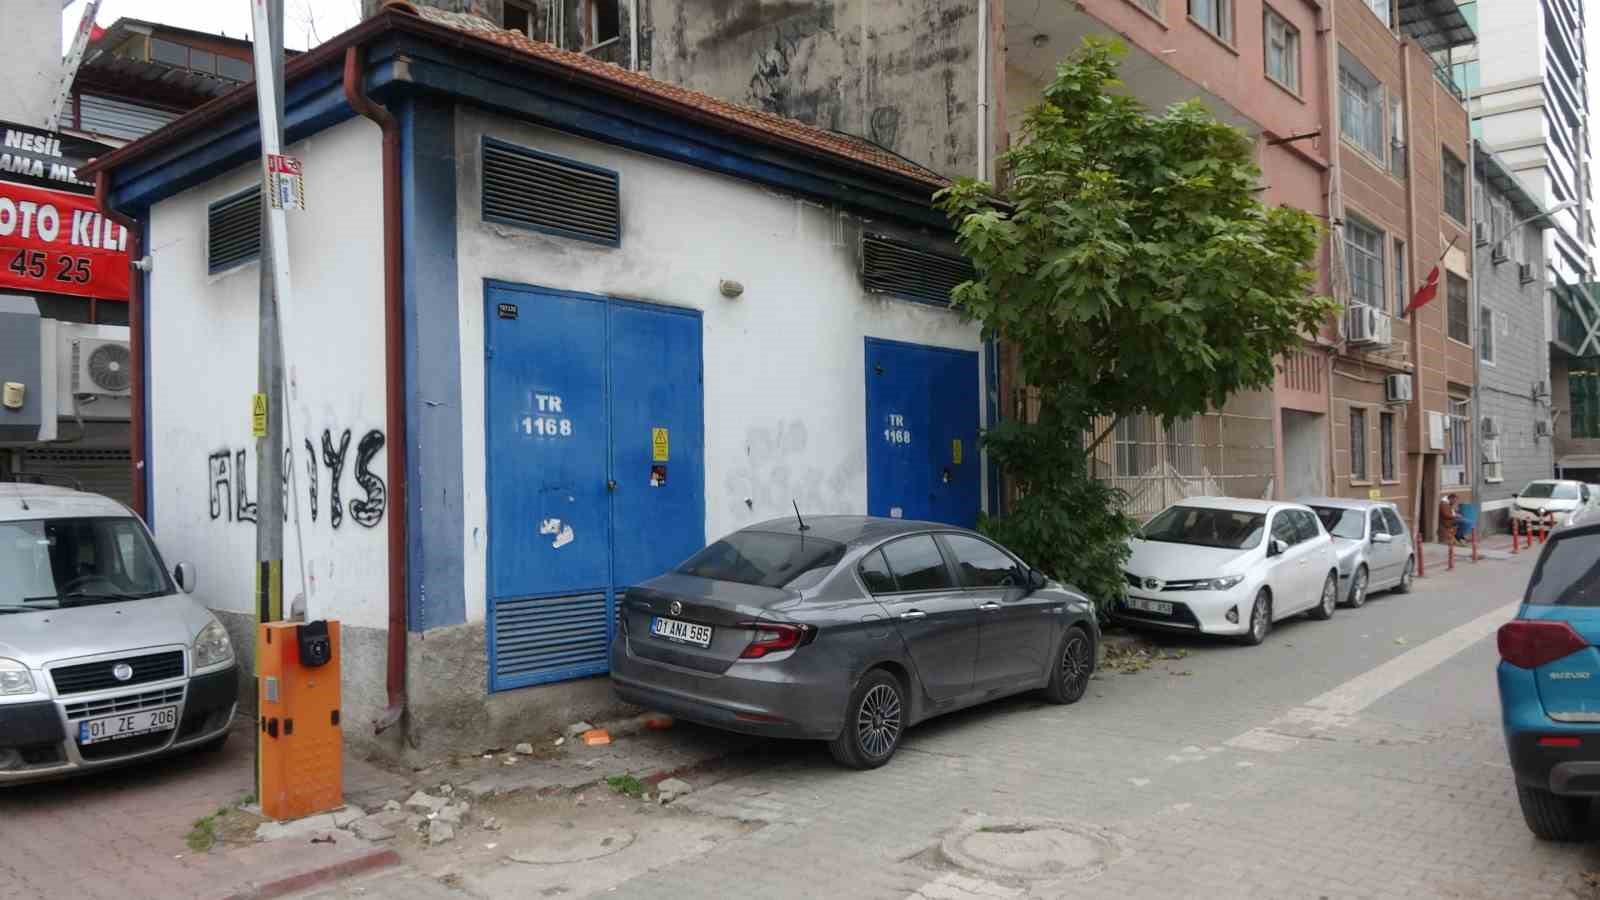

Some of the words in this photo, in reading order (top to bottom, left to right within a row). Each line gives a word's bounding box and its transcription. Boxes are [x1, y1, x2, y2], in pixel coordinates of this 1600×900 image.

[5, 130, 62, 157] NESİL
[0, 197, 60, 242] OTO
[10, 250, 46, 278] 45
[57, 256, 91, 283] 25
[535, 394, 562, 413] TR
[521, 417, 572, 436] 1168
[889, 414, 904, 427] TR
[884, 429, 911, 443] 1168
[656, 619, 668, 633] 01
[670, 622, 688, 639] ANA
[90, 720, 105, 737] 01
[118, 716, 135, 732] ZE
[150, 710, 174, 727] 206
